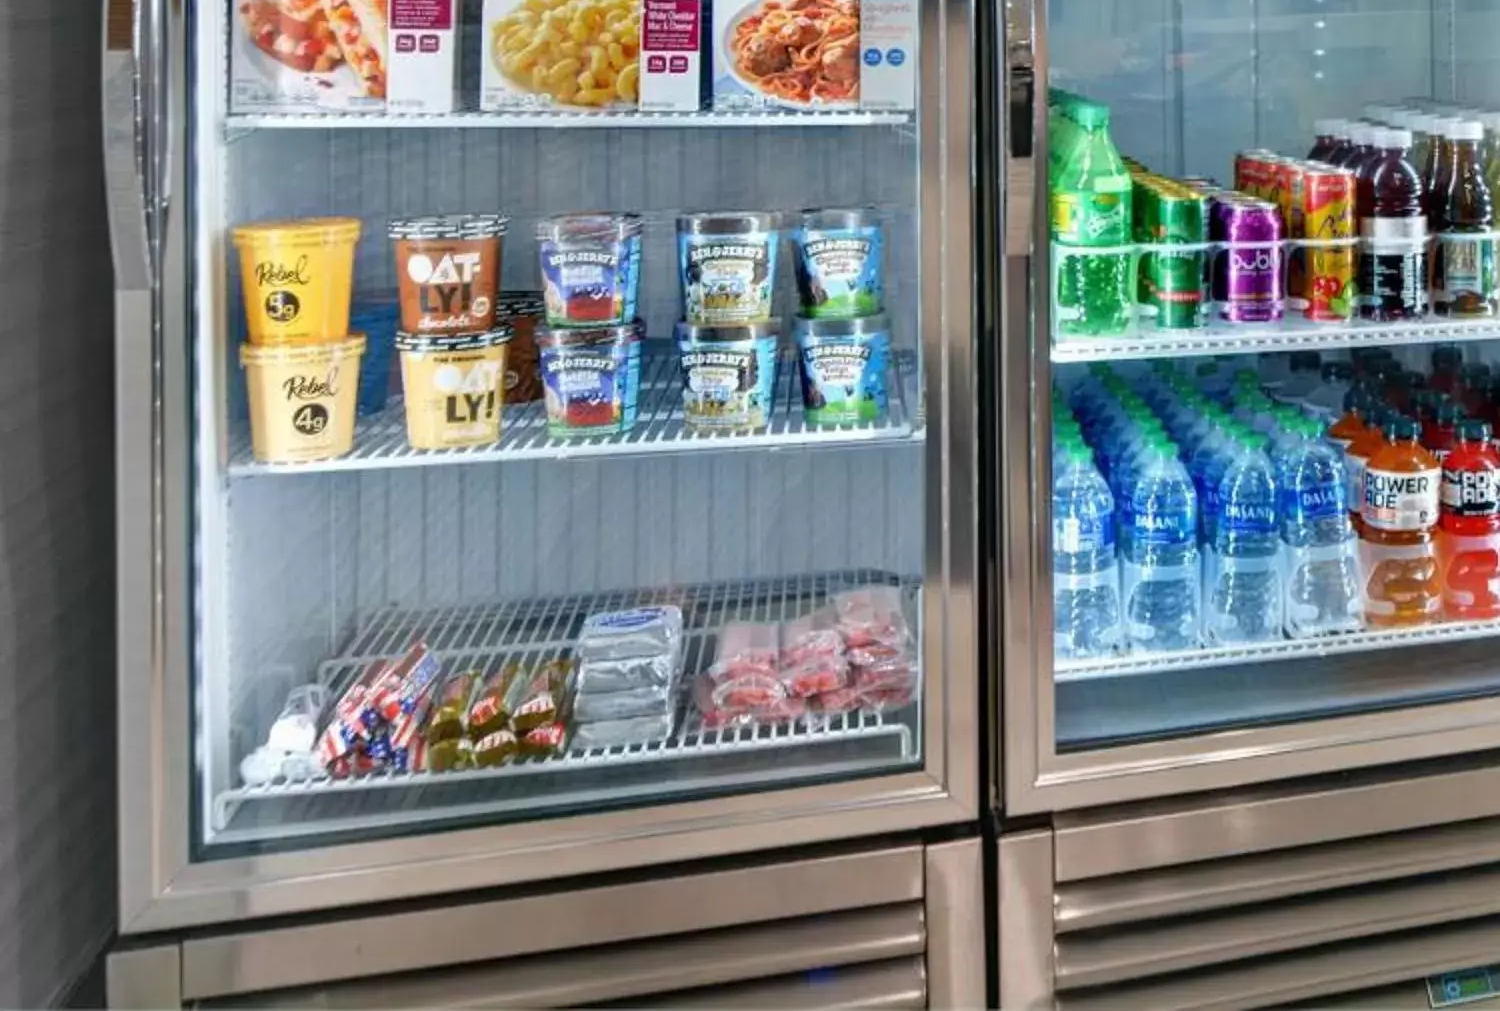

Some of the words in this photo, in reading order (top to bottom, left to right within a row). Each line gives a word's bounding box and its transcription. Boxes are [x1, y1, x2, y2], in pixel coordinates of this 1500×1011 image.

[255, 254, 310, 286] Rebel
[283, 366, 338, 401] Rebel
[295, 407, 323, 431] 4g
[446, 391, 495, 423] LY!
[1364, 473, 1429, 494] POWER
[1365, 492, 1397, 510] ADE
[1225, 504, 1275, 524] DASANI
